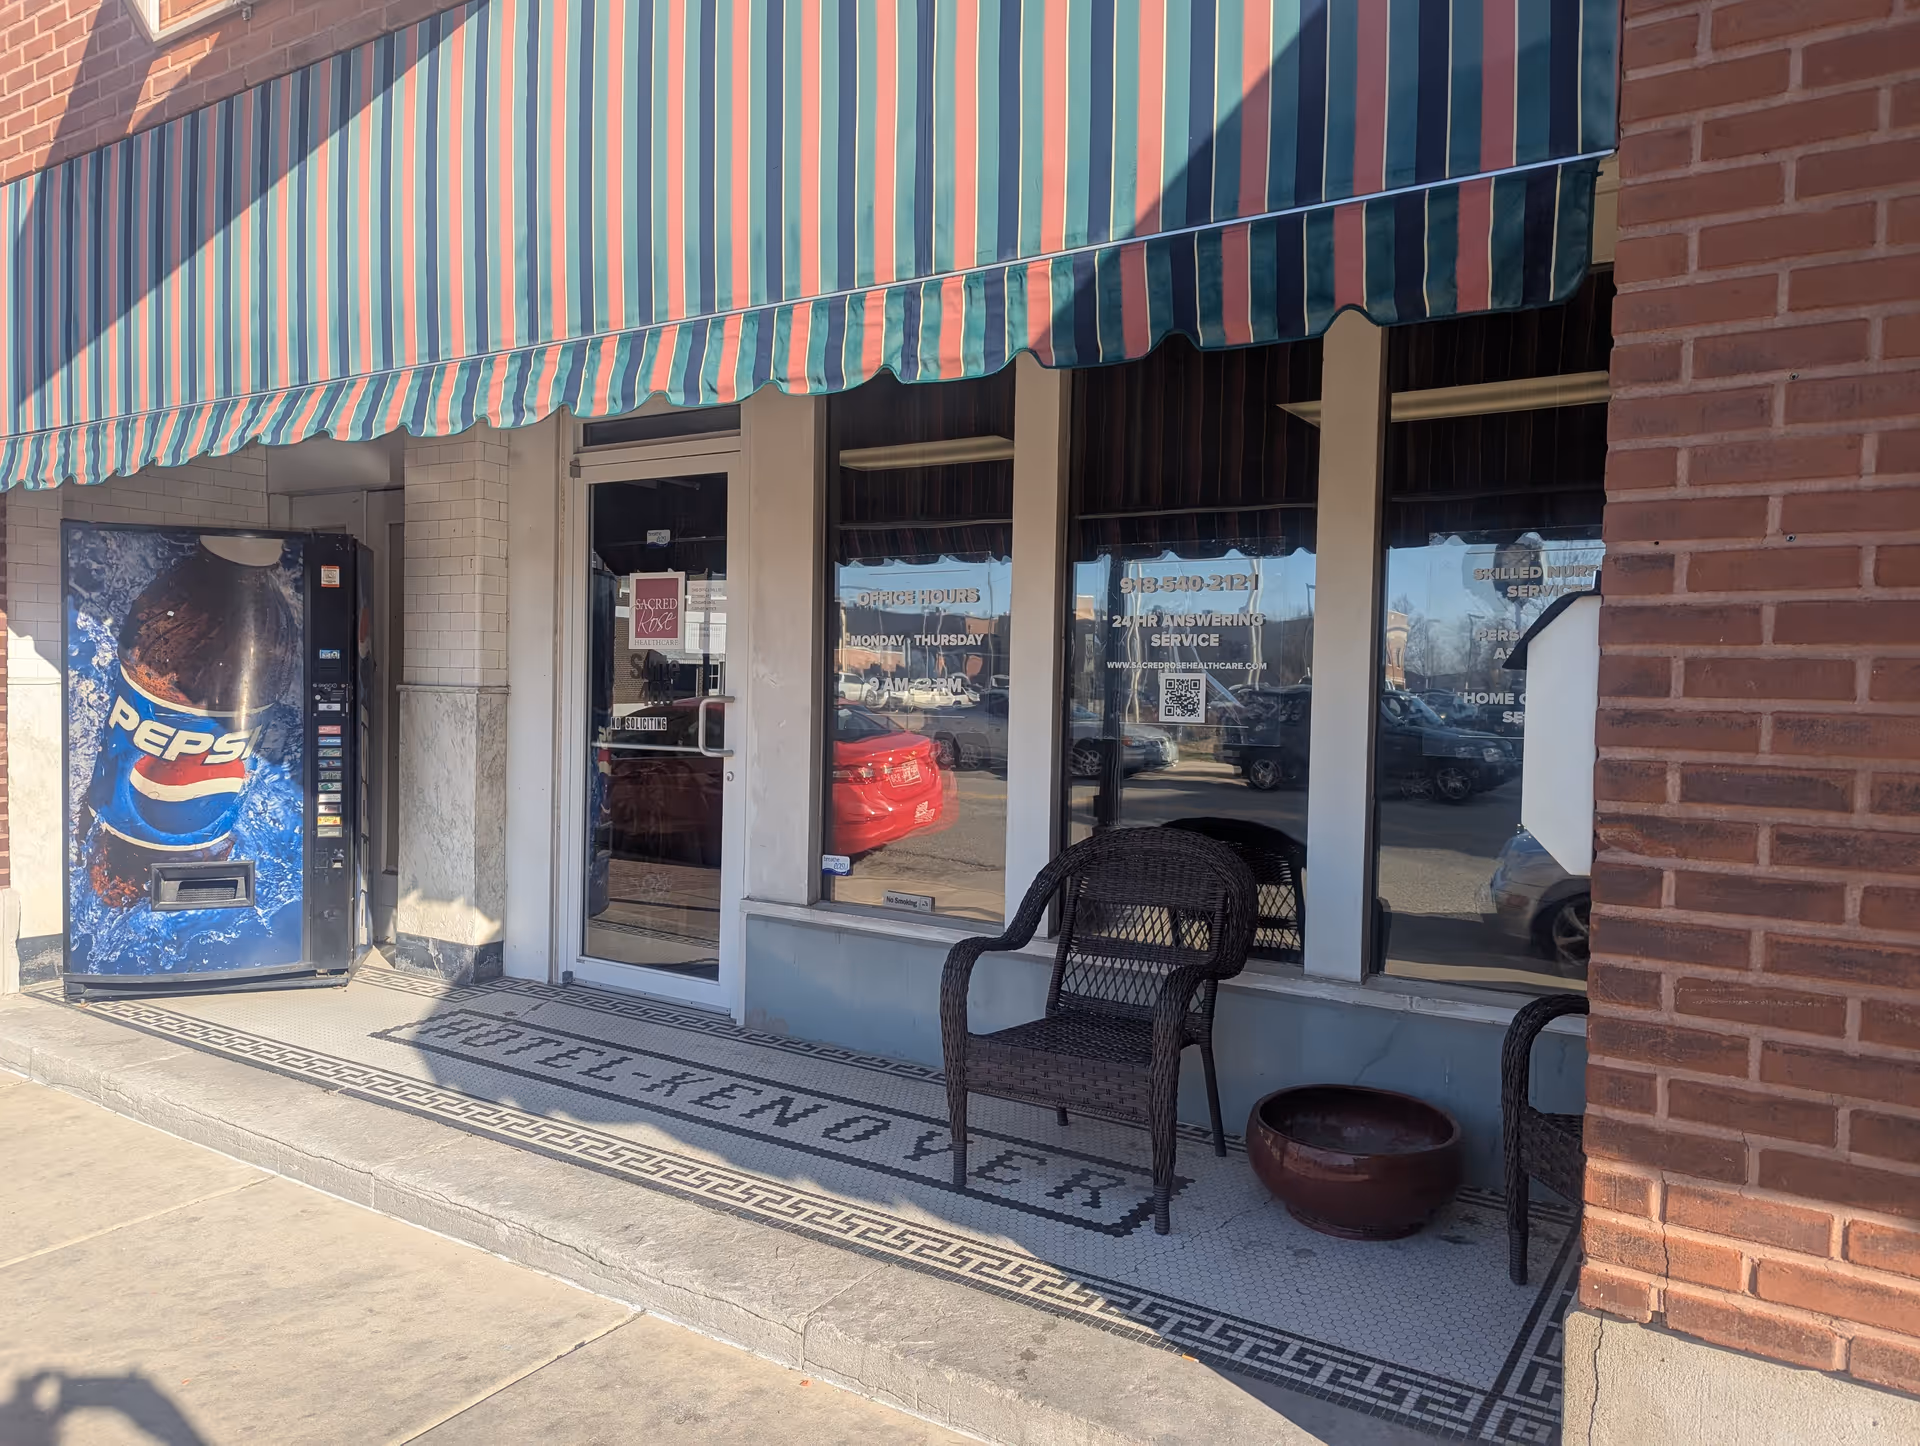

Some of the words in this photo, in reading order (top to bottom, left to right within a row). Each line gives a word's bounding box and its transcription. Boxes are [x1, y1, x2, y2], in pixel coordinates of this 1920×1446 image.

[1473, 566, 1543, 580] SKILLED
[1120, 574, 1259, 594] 918-540-2121
[635, 598, 678, 610] SACRED
[857, 590, 916, 606] OFFICE
[918, 588, 980, 604] HOURS
[636, 605, 676, 634] Rose
[1112, 615, 1132, 628] 24
[1135, 614, 1158, 628] HR
[1161, 613, 1266, 627] ANSWERING
[850, 634, 905, 646] MONDAY
[914, 633, 984, 646] THURSDAY
[1151, 633, 1220, 647] SERVICE
[1106, 661, 1268, 671] WWW.SACREDROSEHEALTHCARE.COM
[869, 677, 880, 692] 9
[884, 677, 909, 692] AM
[936, 677, 962, 693] PM
[1463, 692, 1515, 705] HOME
[109, 695, 263, 765] PEPSI
[611, 717, 621, 730] NO
[625, 717, 667, 730] SOLICITING
[886, 895, 894, 903] No
[894, 897, 918, 908] Smoking
